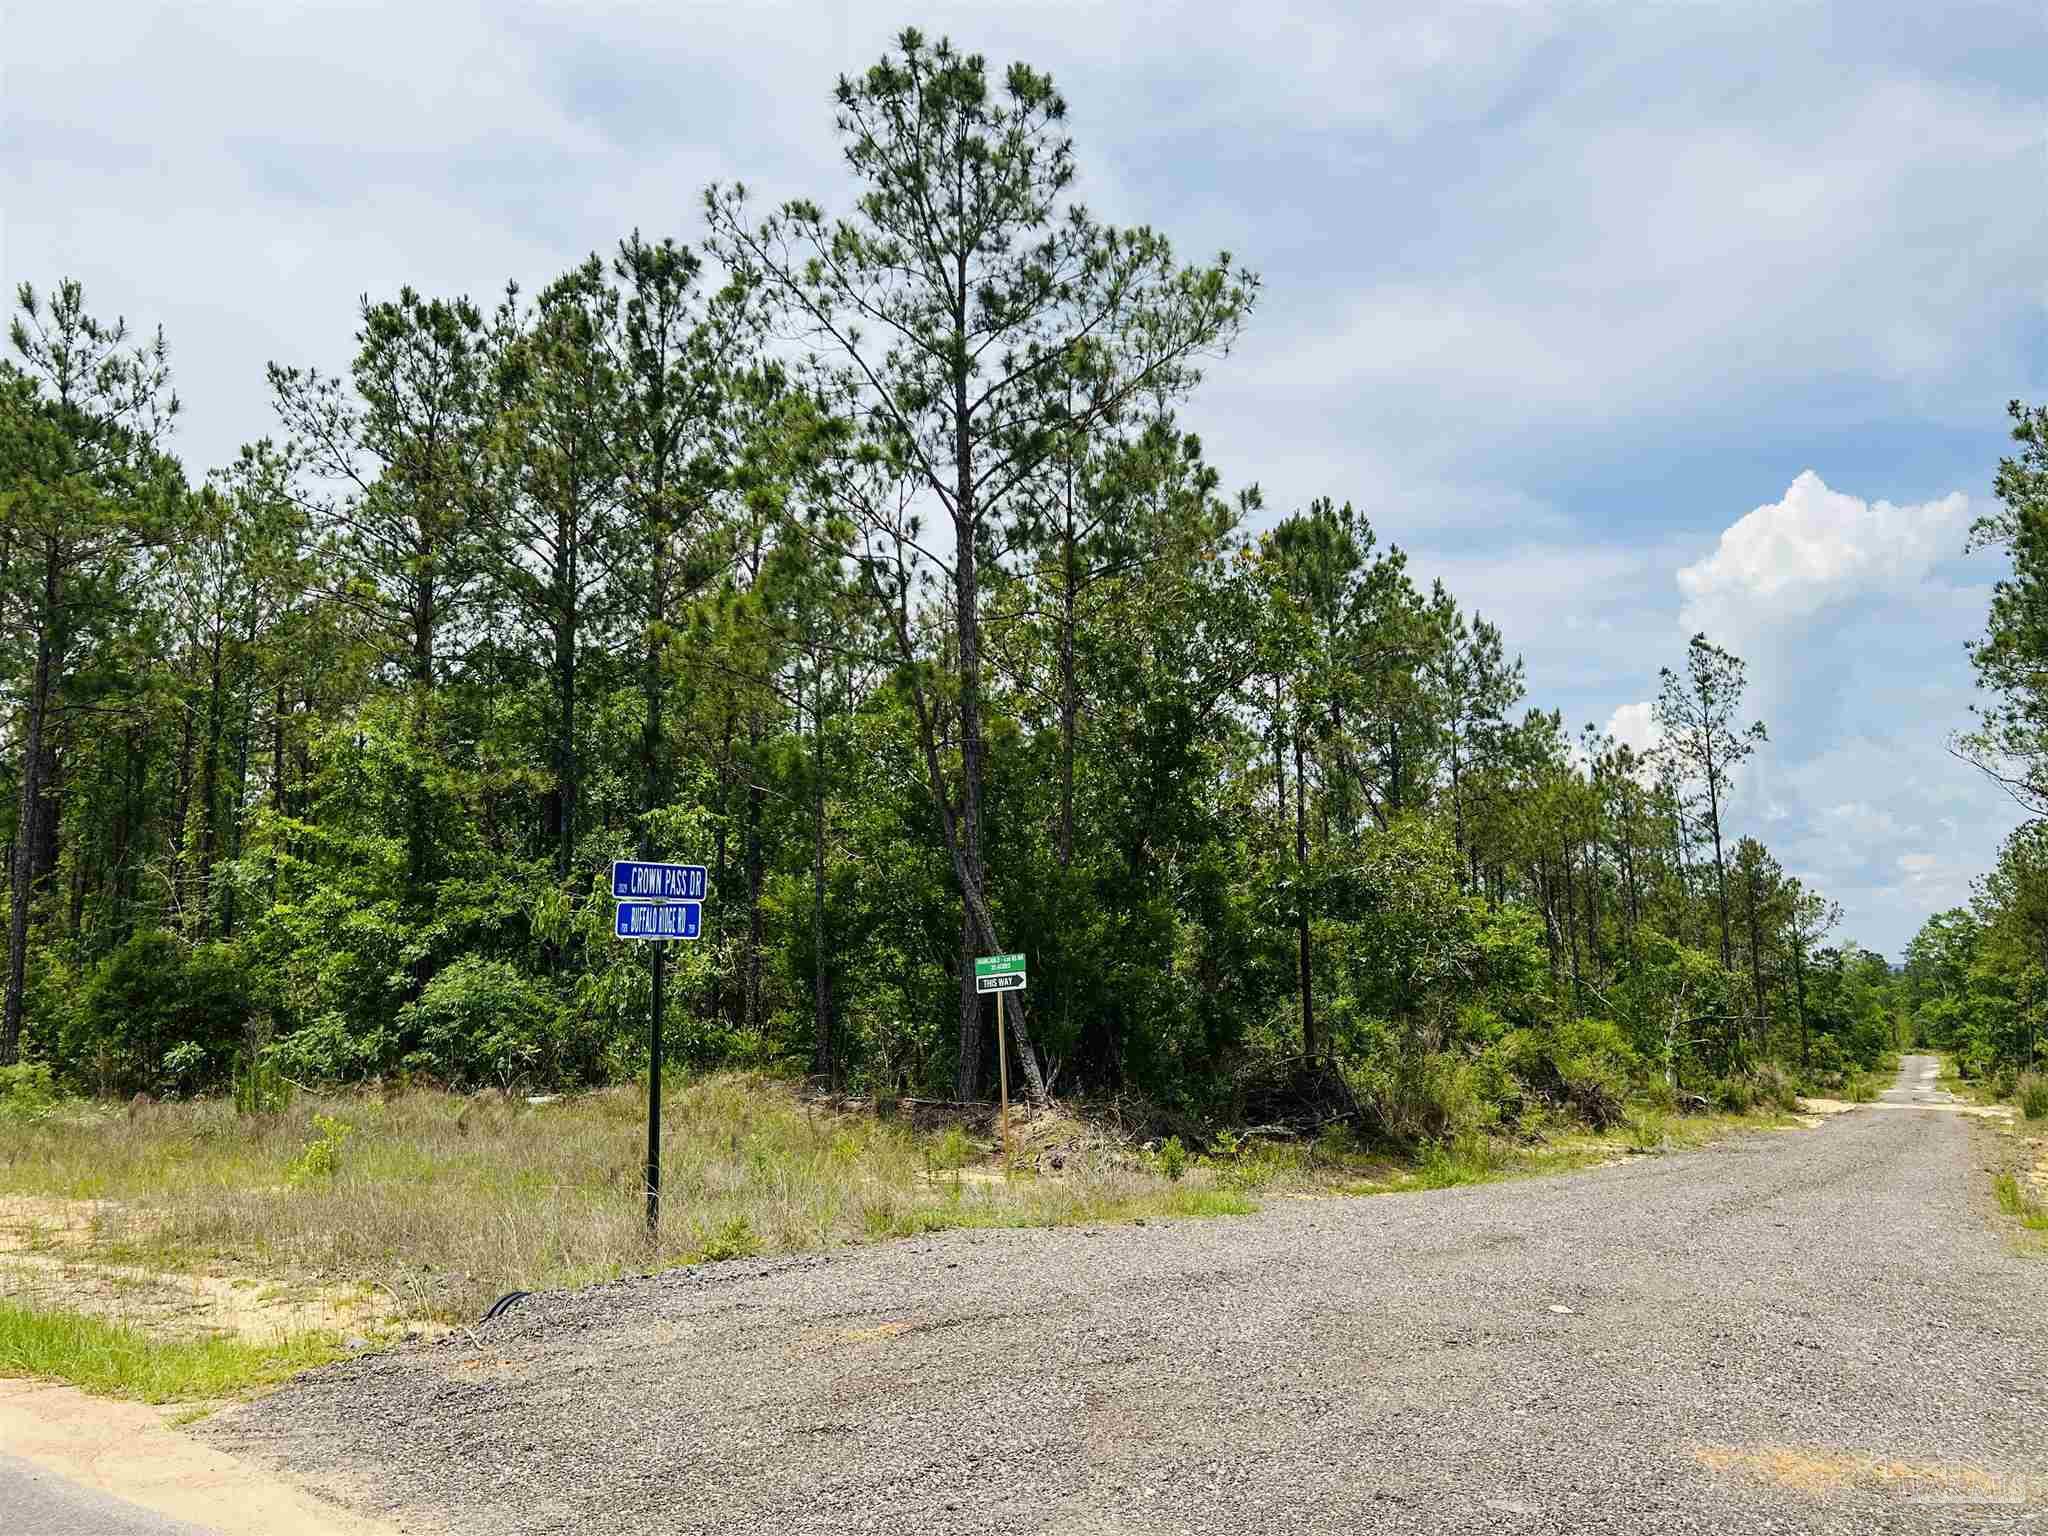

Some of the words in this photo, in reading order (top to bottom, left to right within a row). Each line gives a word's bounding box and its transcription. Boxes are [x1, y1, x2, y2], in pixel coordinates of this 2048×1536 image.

[632, 867, 662, 893] CROWN
[665, 869, 687, 895] PASS
[689, 870, 702, 896] DR
[630, 906, 657, 933] BUFFALO
[659, 907, 676, 933] RIDGE
[678, 907, 686, 933] RD
[983, 979, 998, 988] THIS
[998, 977, 1013, 987] WAY
